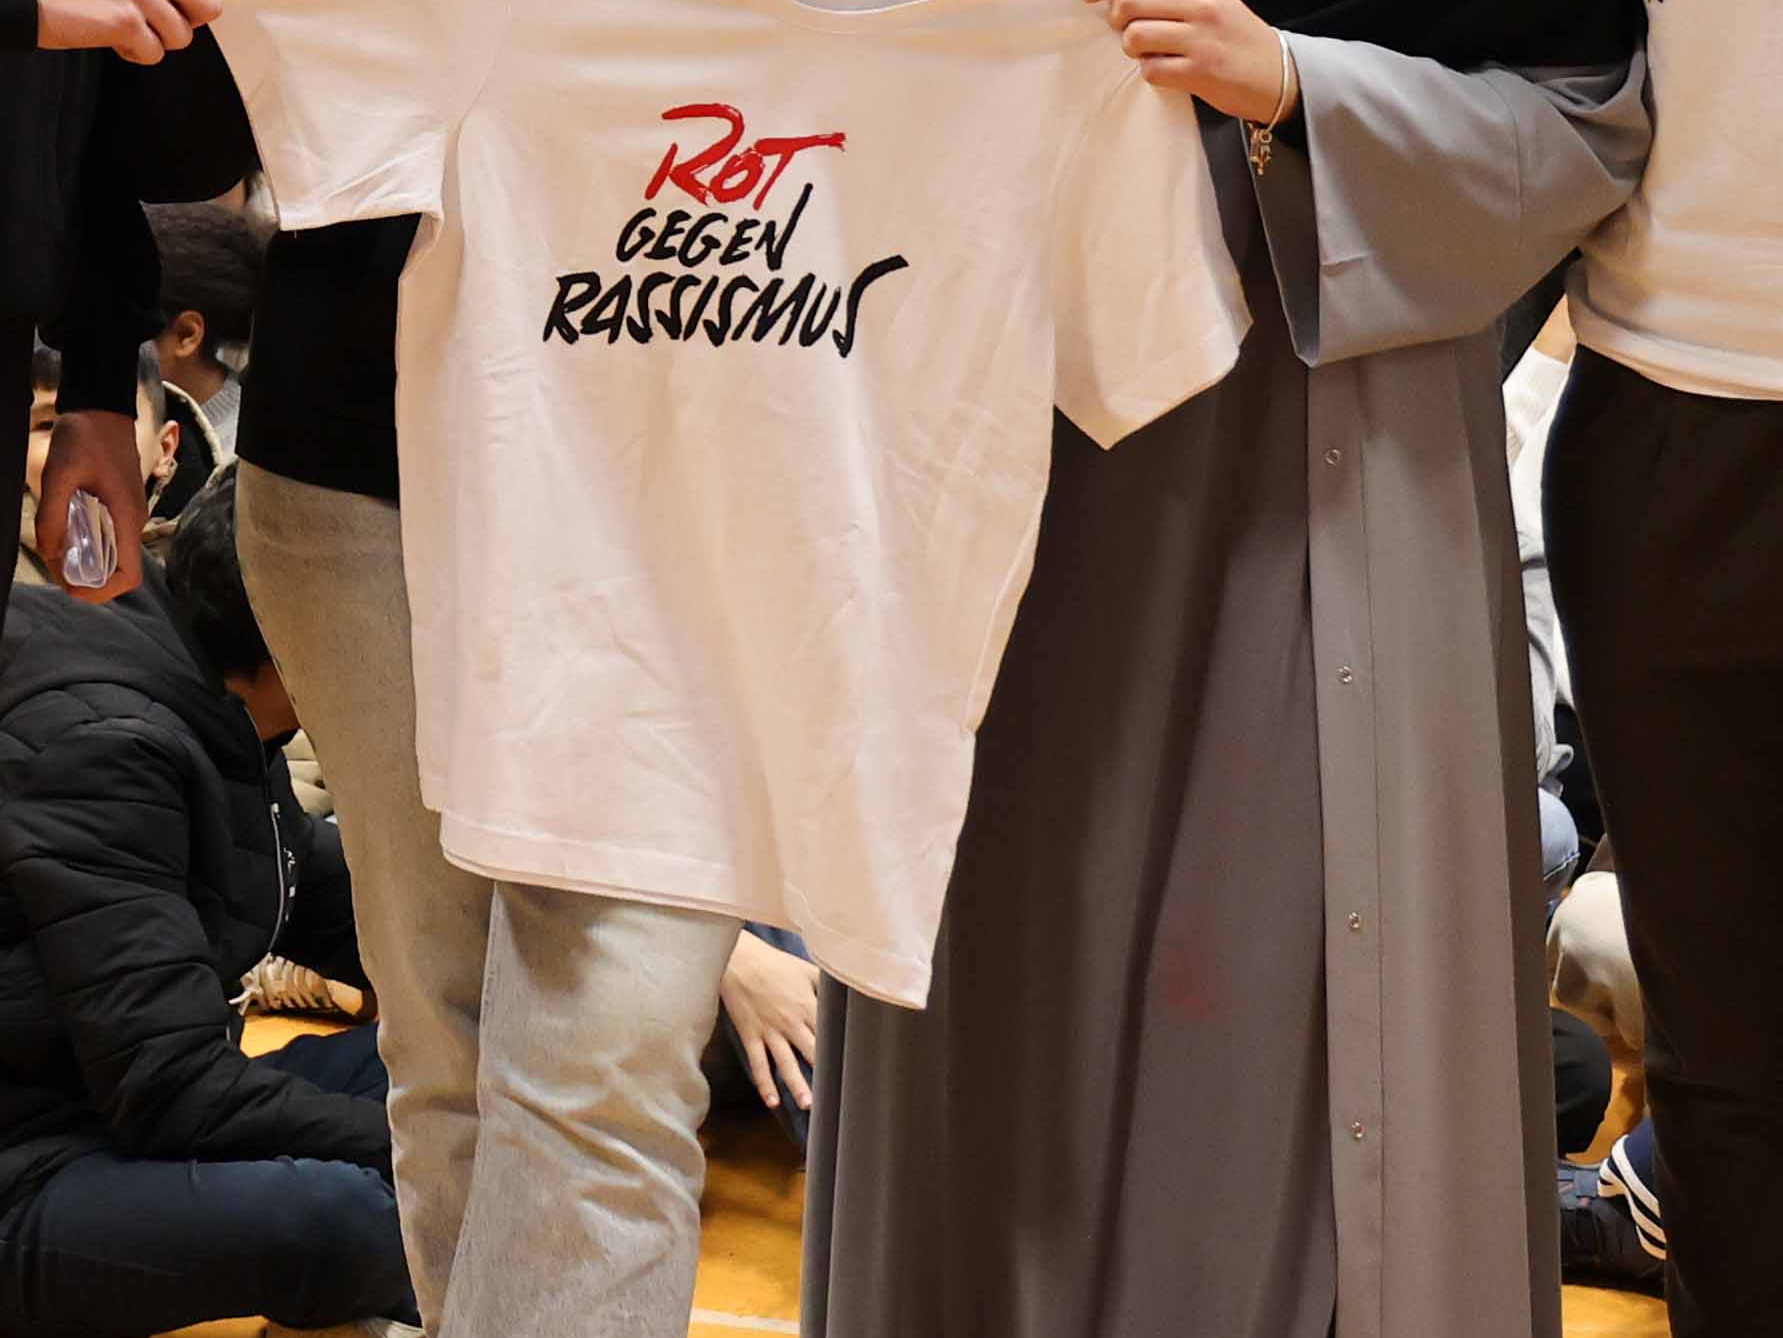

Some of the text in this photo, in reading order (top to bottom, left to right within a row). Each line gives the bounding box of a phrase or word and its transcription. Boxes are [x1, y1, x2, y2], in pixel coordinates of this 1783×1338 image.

[643, 102, 847, 211] ROT
[615, 182, 814, 271] GEGEN
[542, 253, 910, 359] RASSISMUS
